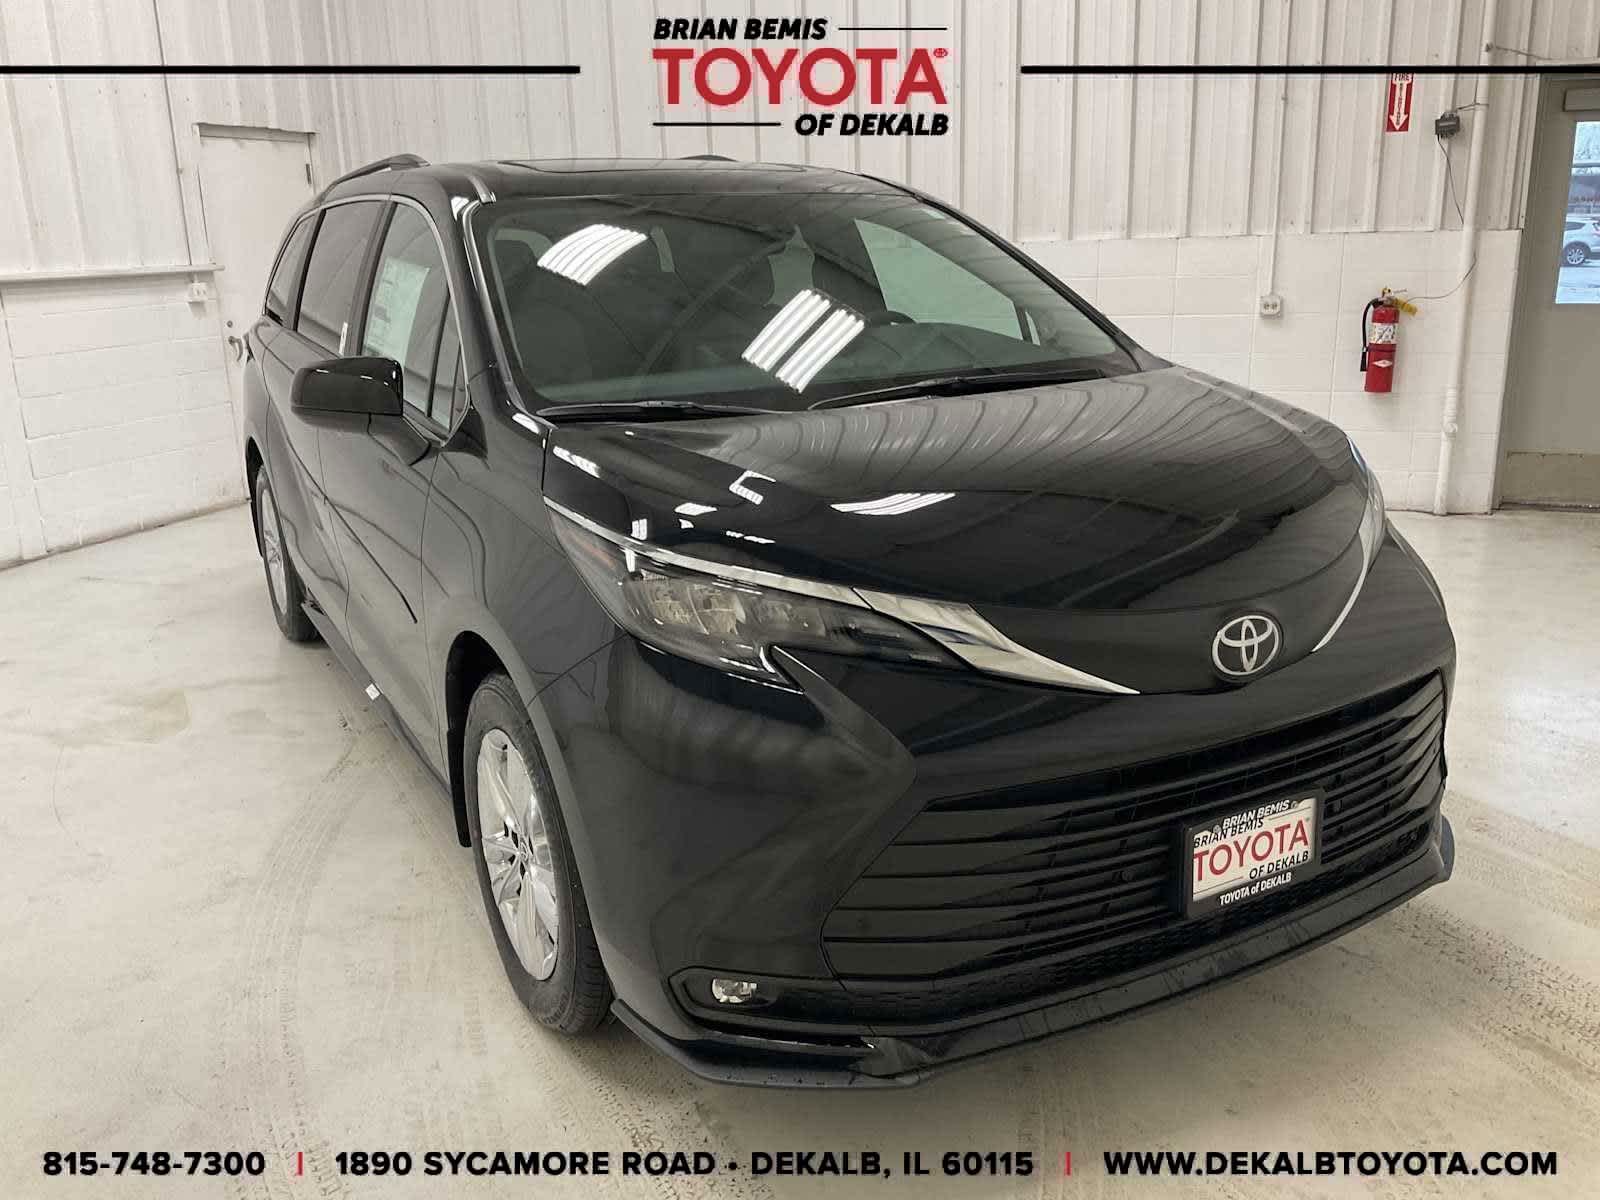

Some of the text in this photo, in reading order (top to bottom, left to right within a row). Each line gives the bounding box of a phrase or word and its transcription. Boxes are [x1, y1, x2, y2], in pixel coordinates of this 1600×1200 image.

[1222, 799, 1290, 829] BRIAN BEMIS
[1193, 818, 1264, 848] BRIAN BEMIS
[1193, 820, 1309, 881] TOYOTA
[1249, 850, 1309, 880] OF DEKALB
[1219, 872, 1292, 906] TOYOTA of DEKALB
